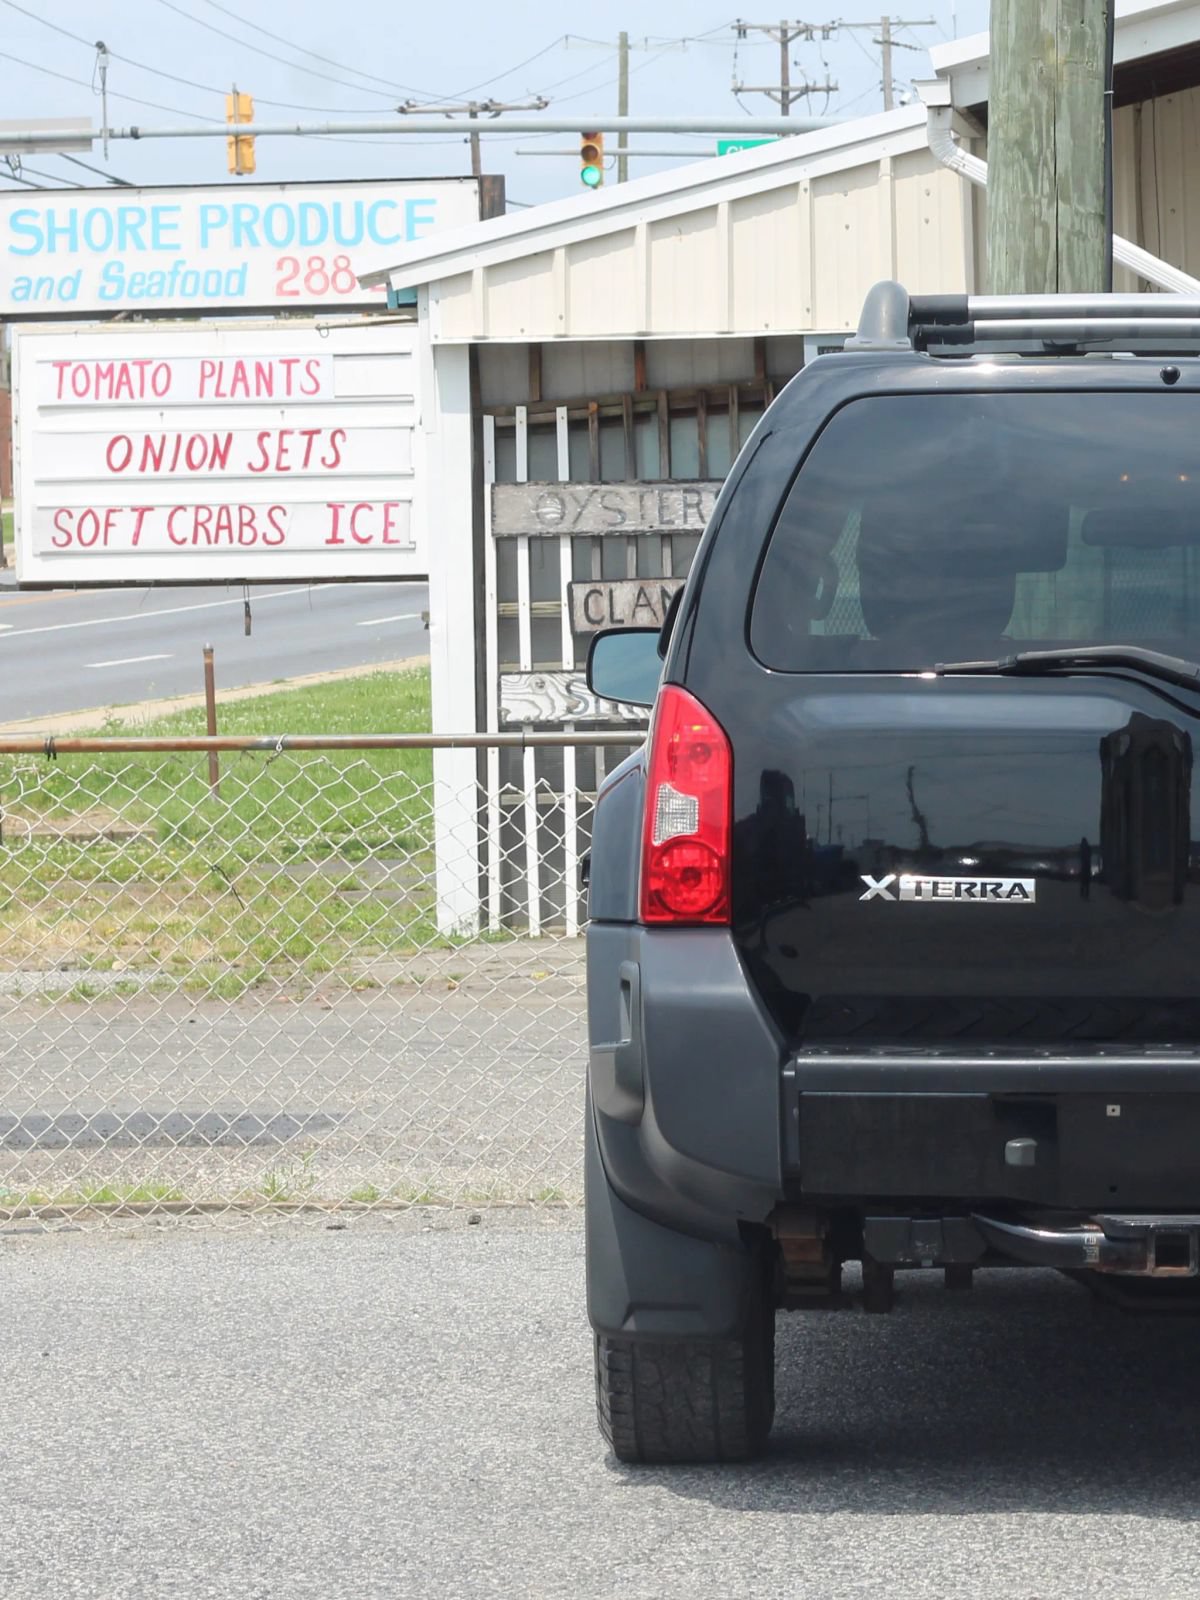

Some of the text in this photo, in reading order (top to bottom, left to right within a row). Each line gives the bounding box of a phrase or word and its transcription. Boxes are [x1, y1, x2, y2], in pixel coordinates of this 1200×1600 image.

[8, 198, 438, 257] SHORE PRODUCE
[11, 269, 82, 302] and
[98, 259, 249, 301] Seafood
[52, 358, 321, 400] TOMATO PLANTS
[106, 428, 347, 473] ONION SETS
[51, 502, 401, 548] SOFT CRABS ICE
[535, 487, 724, 527] OYSTER
